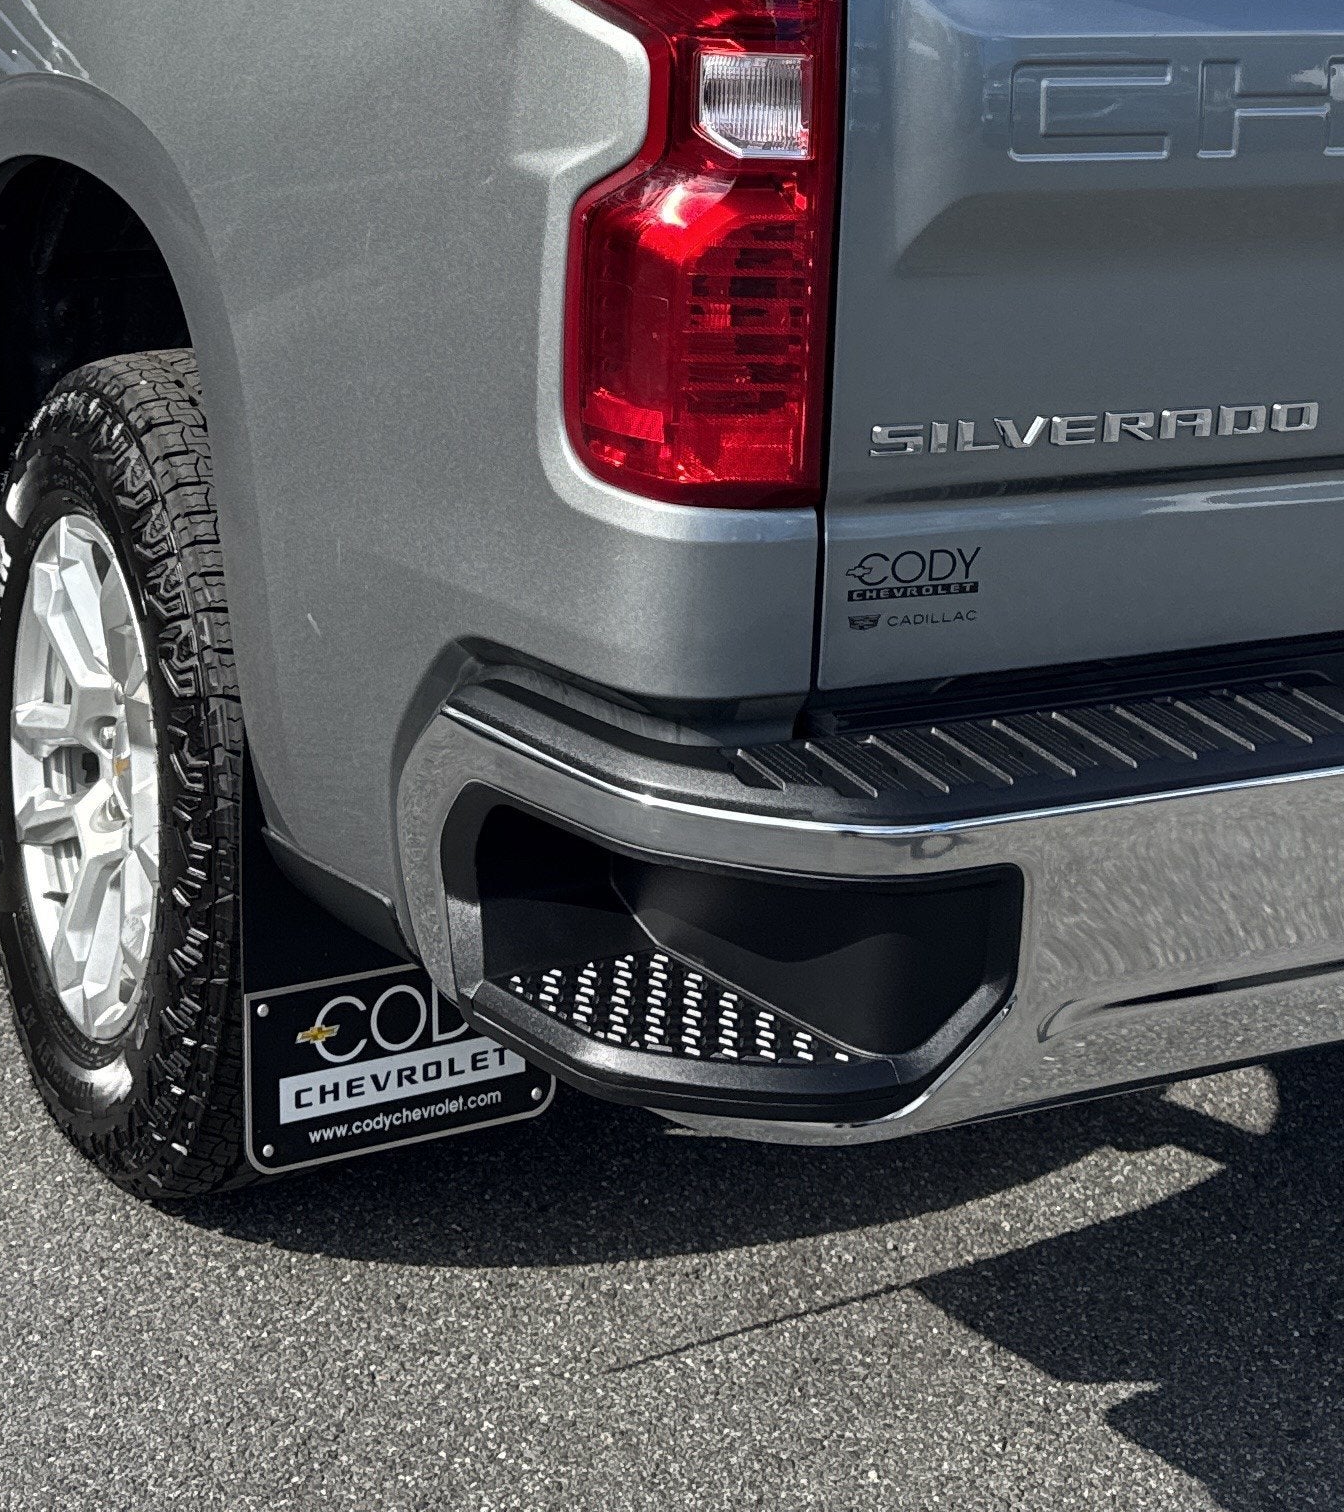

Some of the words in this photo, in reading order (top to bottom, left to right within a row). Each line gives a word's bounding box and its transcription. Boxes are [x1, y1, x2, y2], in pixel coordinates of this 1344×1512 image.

[868, 401, 1320, 457] SILVERADO
[850, 546, 982, 586] CODY
[852, 582, 975, 601] CHEVROLET
[887, 609, 977, 627] CADILLAC
[313, 982, 471, 1064] COD
[294, 1046, 510, 1110] CHEVROLET
[308, 1090, 502, 1144] www.codychevrolet.com
